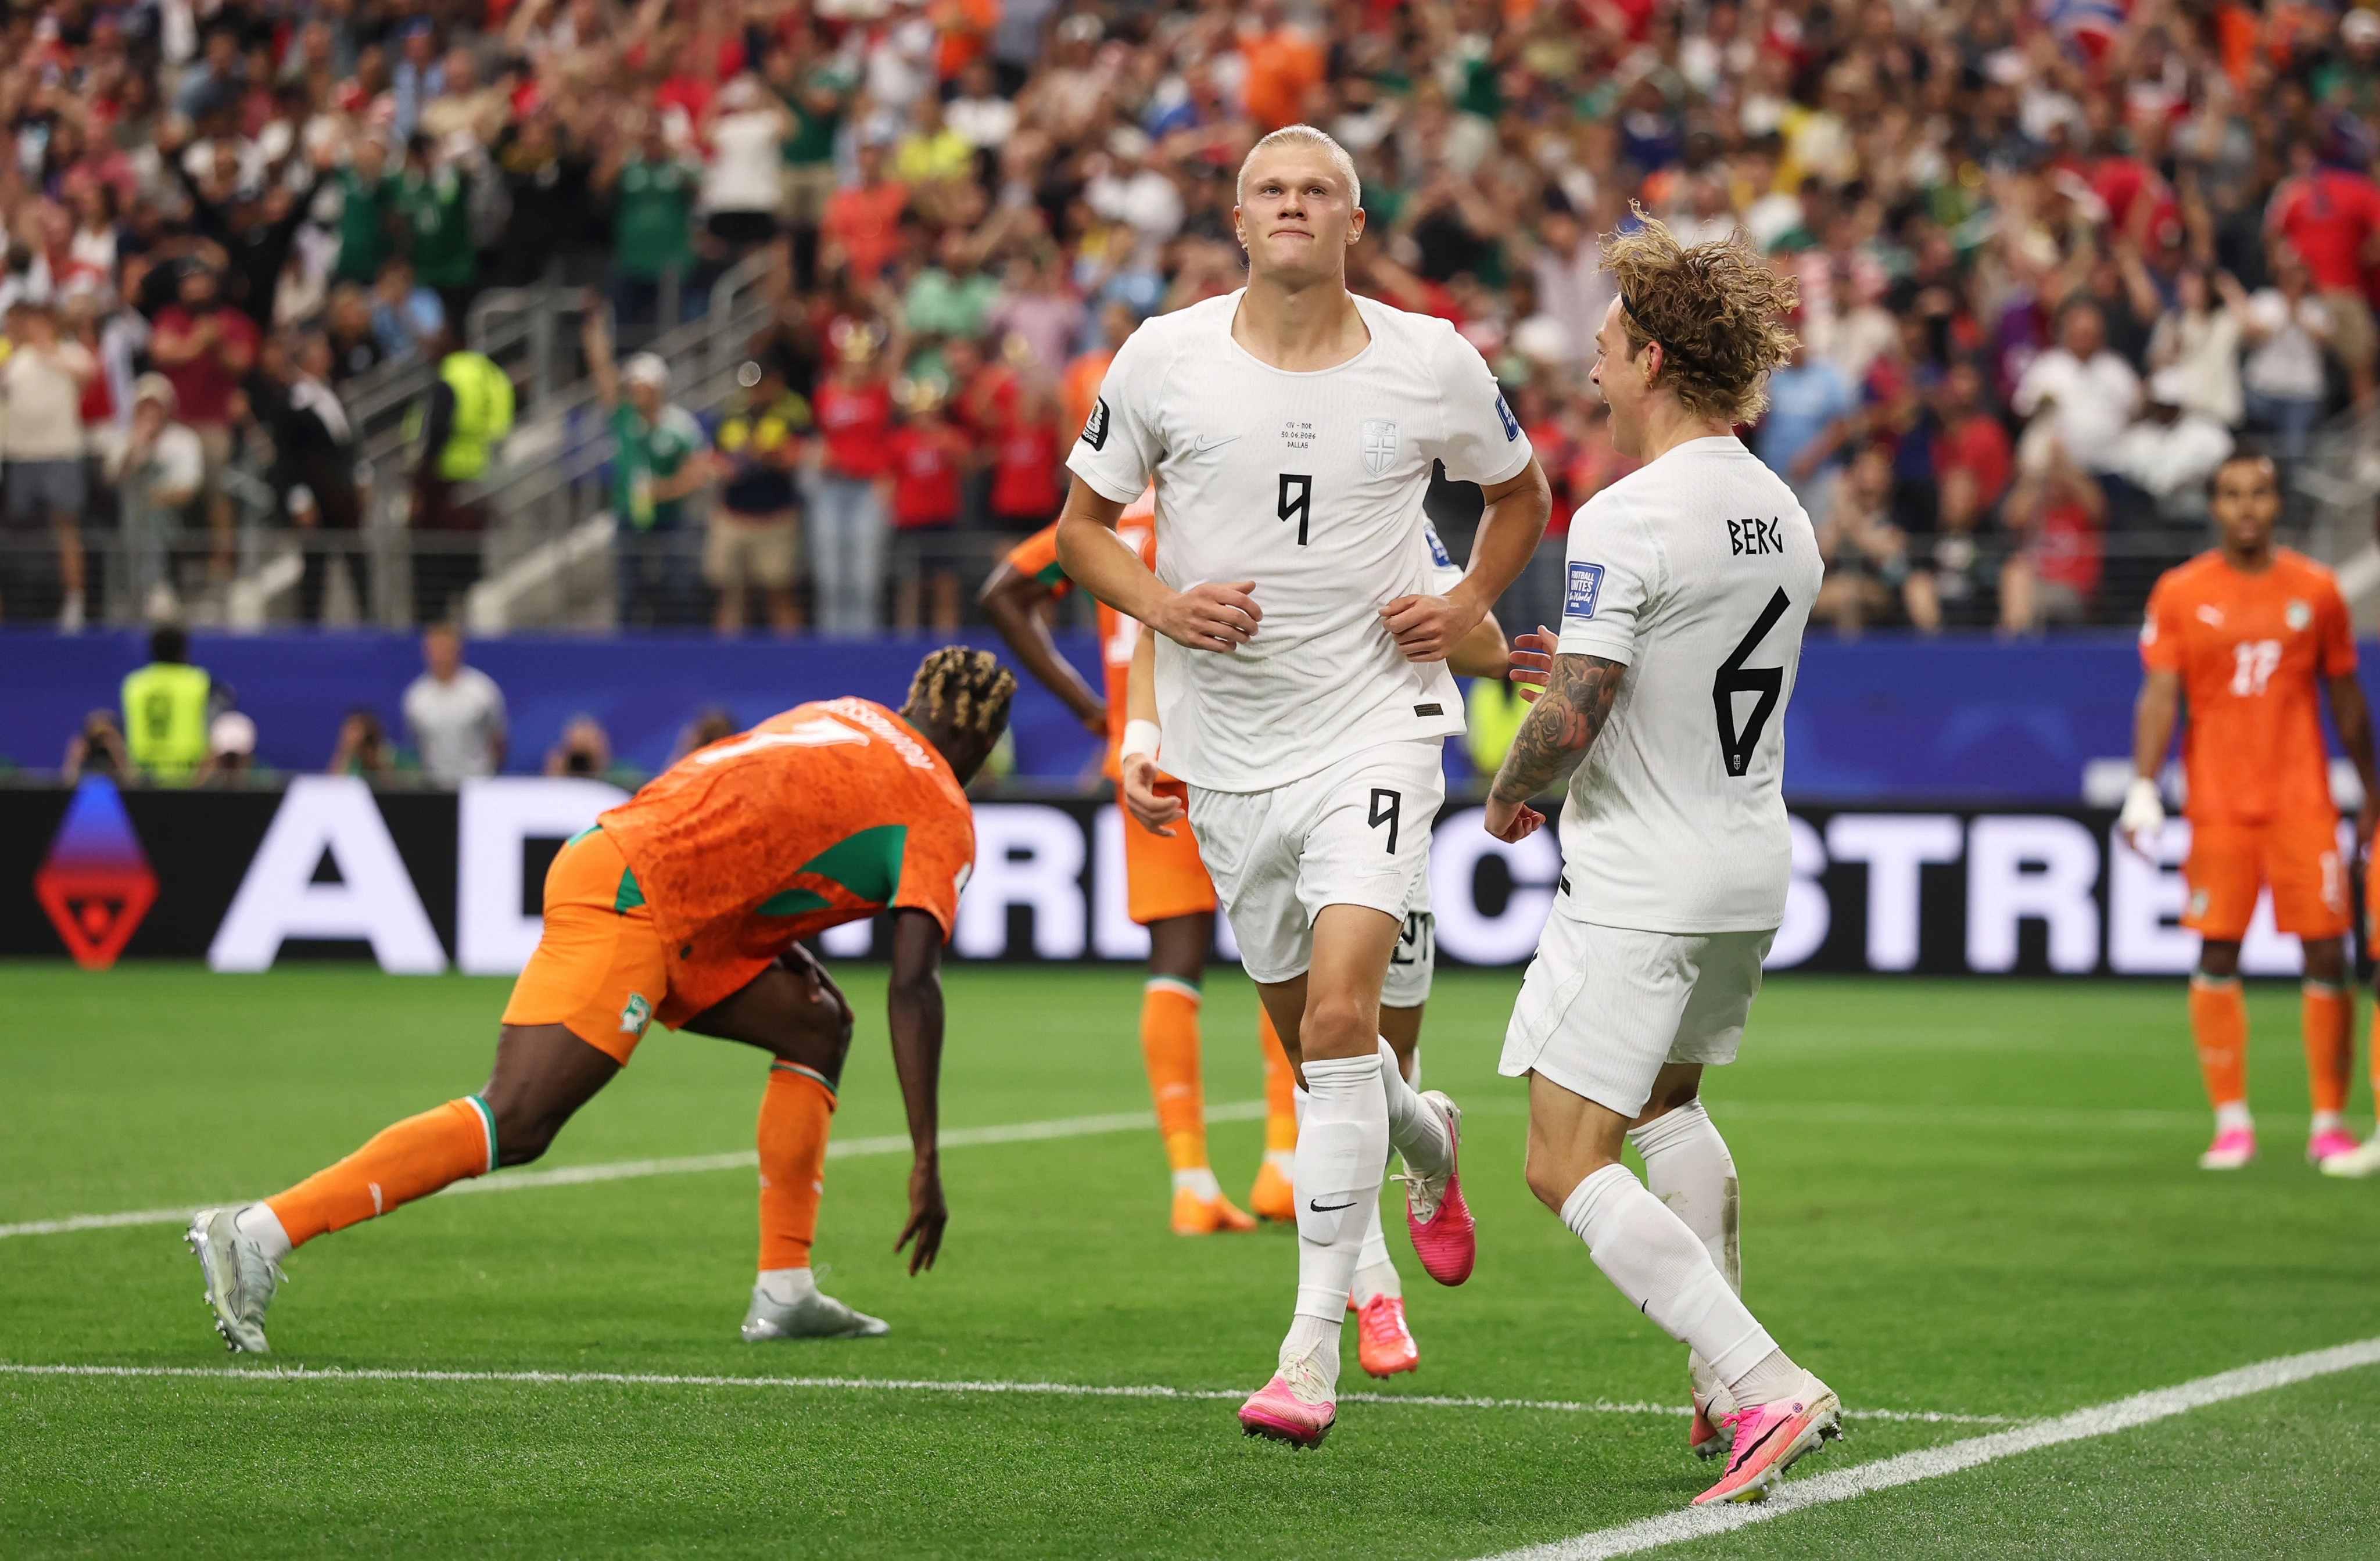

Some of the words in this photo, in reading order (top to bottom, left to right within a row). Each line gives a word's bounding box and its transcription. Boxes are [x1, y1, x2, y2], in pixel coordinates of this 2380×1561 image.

[1281, 431, 1316, 440] 30.06.2026
[1287, 441, 1309, 449] DALLAS
[1277, 473, 1313, 546] 9
[1727, 516, 1784, 556] BERG
[1571, 570, 1594, 582] FOOTBALL
[1571, 579, 1593, 593] UNITES
[1573, 591, 1593, 604] World
[1712, 585, 1791, 777] 6
[2230, 638, 2283, 697] 17
[1367, 788, 1401, 855] 9
